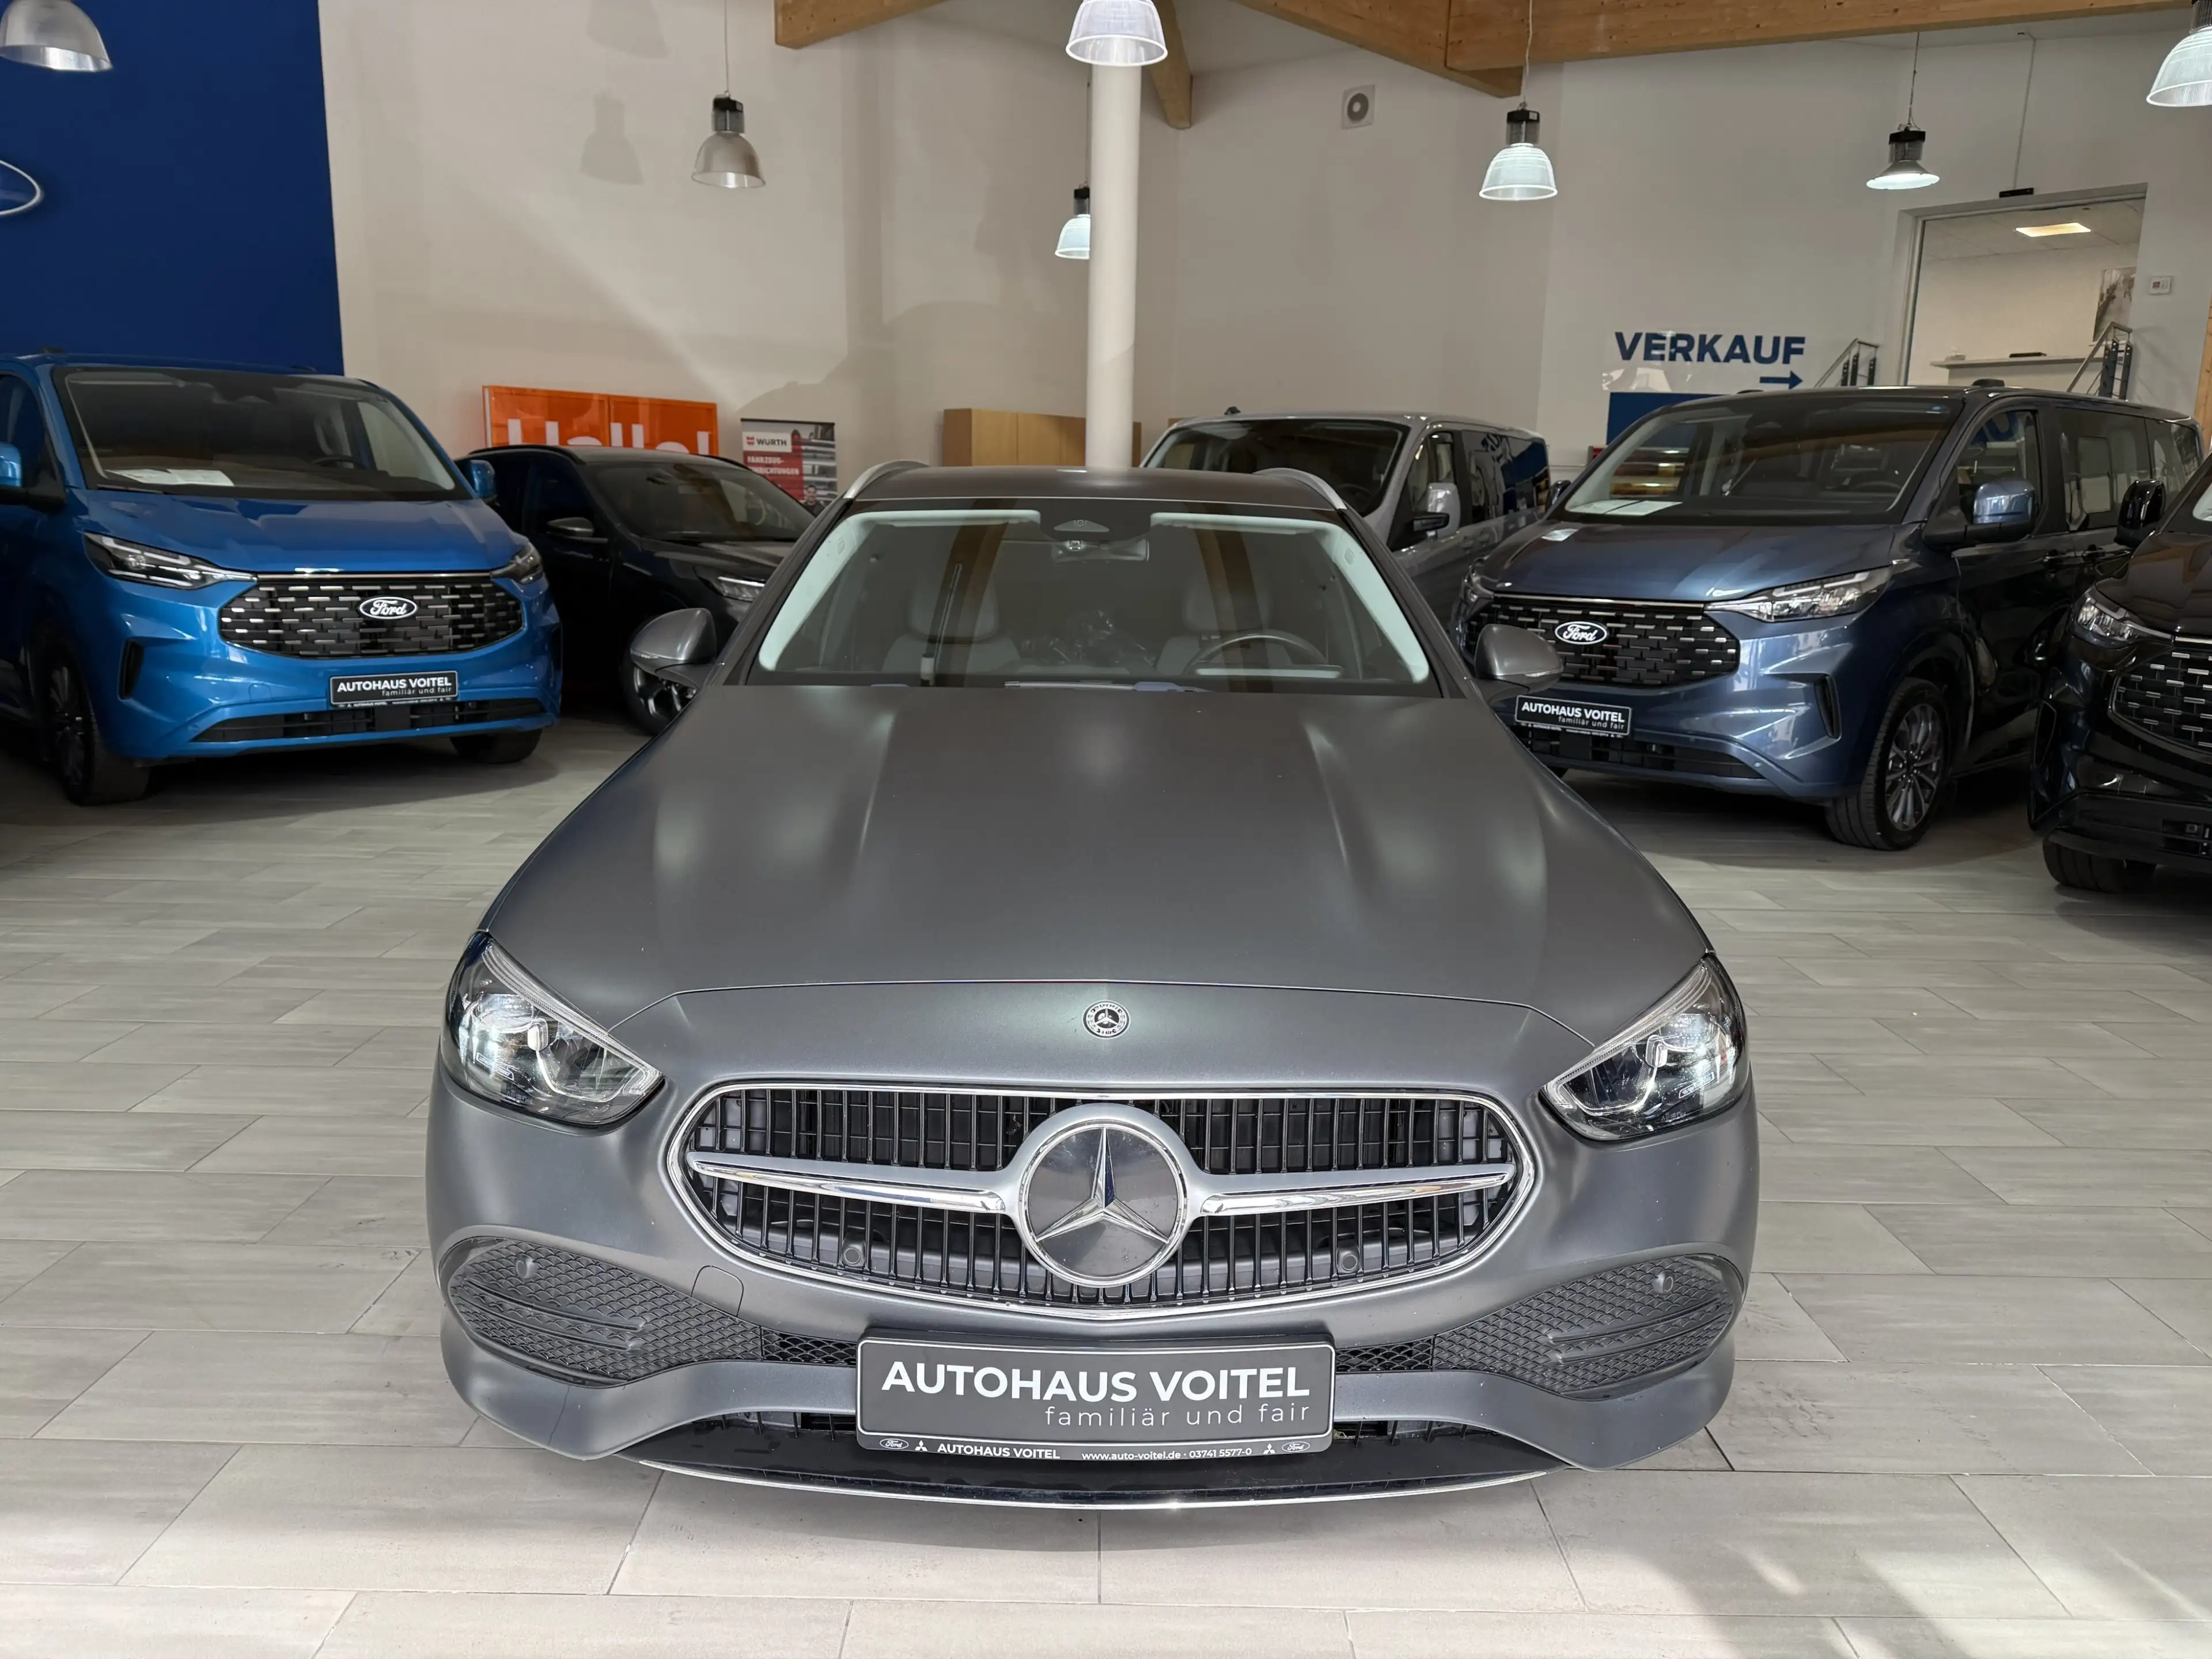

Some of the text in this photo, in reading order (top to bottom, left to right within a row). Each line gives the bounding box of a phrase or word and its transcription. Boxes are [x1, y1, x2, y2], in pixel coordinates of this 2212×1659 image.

[1615, 331, 1806, 364] VERKAUF
[370, 600, 407, 615] Ford
[1563, 624, 1598, 641] Ford
[337, 676, 452, 692] AUTOHAUS VOITEL
[382, 688, 415, 696] familiär
[1521, 702, 1625, 723] AUTOHAUS VOITEL
[1610, 722, 1624, 730] fair
[881, 1361, 1310, 1403] AUTOHAUS VOITEL
[1046, 1403, 1310, 1426] familiär und fair
[937, 1443, 1060, 1459] AUTOHAUS VOITEL
[1082, 1448, 1252, 1461] www.auto-voitel.de 03741 5577-0
